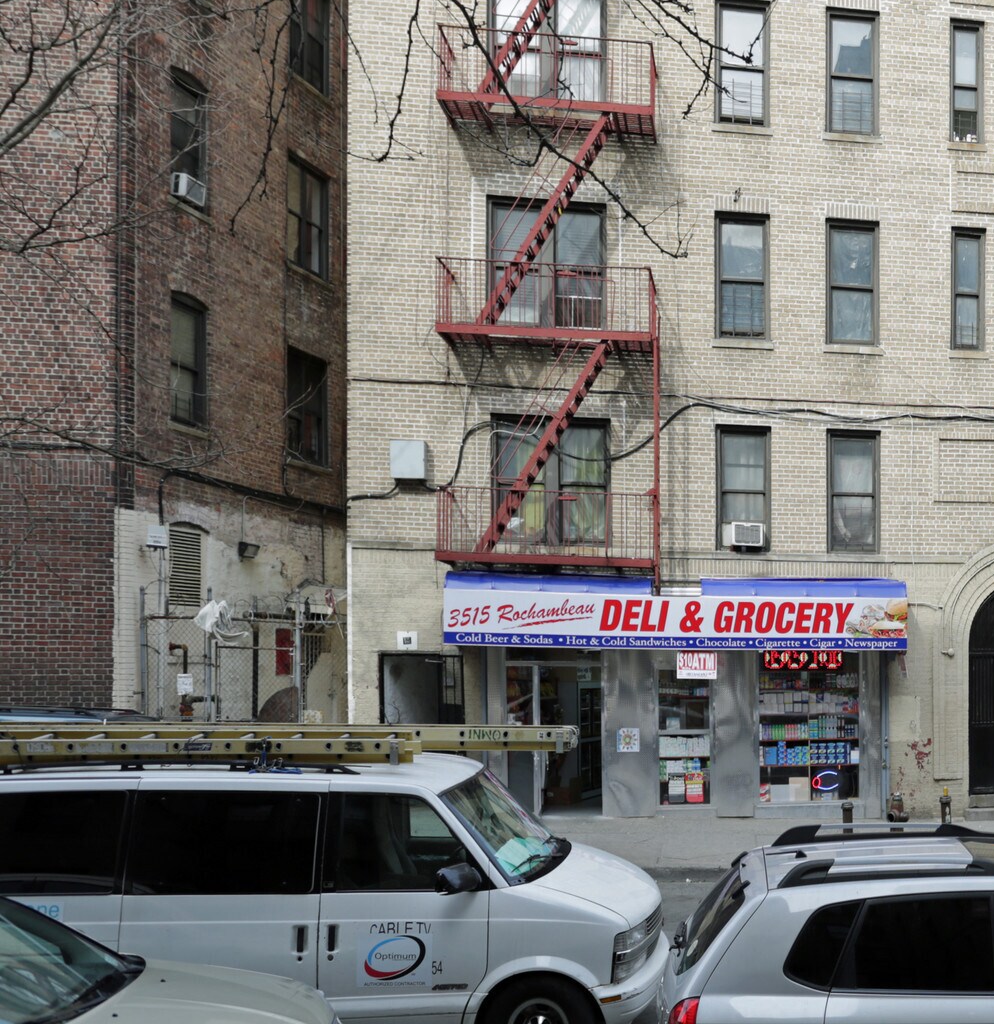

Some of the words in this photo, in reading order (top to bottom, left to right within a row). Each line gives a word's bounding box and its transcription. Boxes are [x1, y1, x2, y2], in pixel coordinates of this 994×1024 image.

[448, 605, 491, 628] 3515
[496, 598, 596, 624] Rochambeau
[599, 599, 670, 632] DELI
[679, 600, 704, 633] &
[713, 601, 854, 634] GROCERY
[455, 633, 482, 643] Cold
[484, 633, 509, 643] Beer
[510, 634, 521, 644] &
[523, 634, 553, 644] Sodas
[566, 636, 588, 645] Hot
[588, 636, 600, 646] &
[601, 636, 627, 646] Cold
[629, 636, 687, 647] Sandwiches
[696, 638, 746, 648] Chocolate
[755, 638, 801, 650] Cigarette
[809, 638, 836, 650] Cigar
[844, 639, 898, 650] Newspaper
[692, 653, 714, 670] ATM
[416, 921, 432, 934] TV
[374, 952, 417, 961] Optimum
[431, 960, 443, 975] 54
